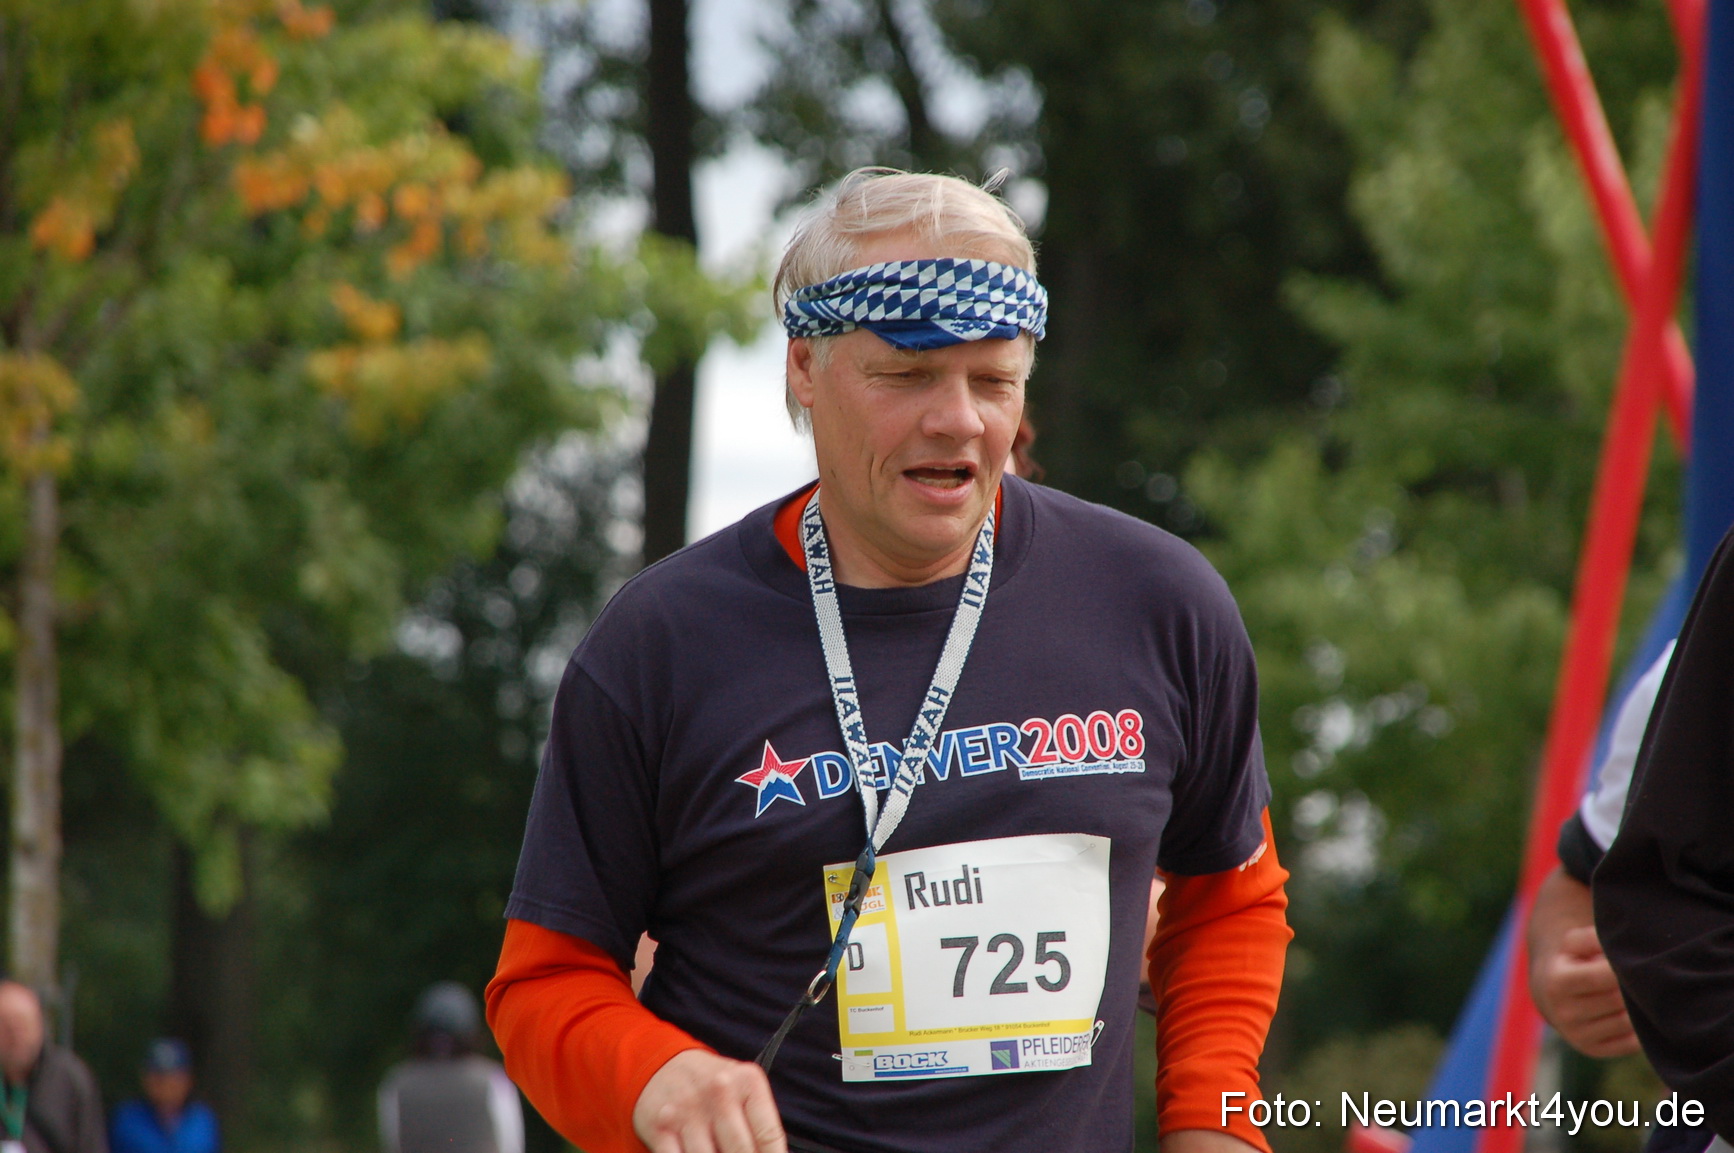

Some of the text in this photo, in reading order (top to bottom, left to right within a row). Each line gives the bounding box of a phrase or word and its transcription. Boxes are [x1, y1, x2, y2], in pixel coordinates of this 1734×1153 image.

[805, 503, 833, 594] HAWAII
[834, 677, 876, 787] HAWAII
[896, 686, 950, 797] HAWAII
[1022, 767, 1055, 777] Democratic
[1057, 765, 1079, 774] National
[904, 864, 983, 910] Rudi
[847, 942, 864, 971] D
[940, 931, 1072, 998] 725
[873, 1050, 948, 1070] BOCK
